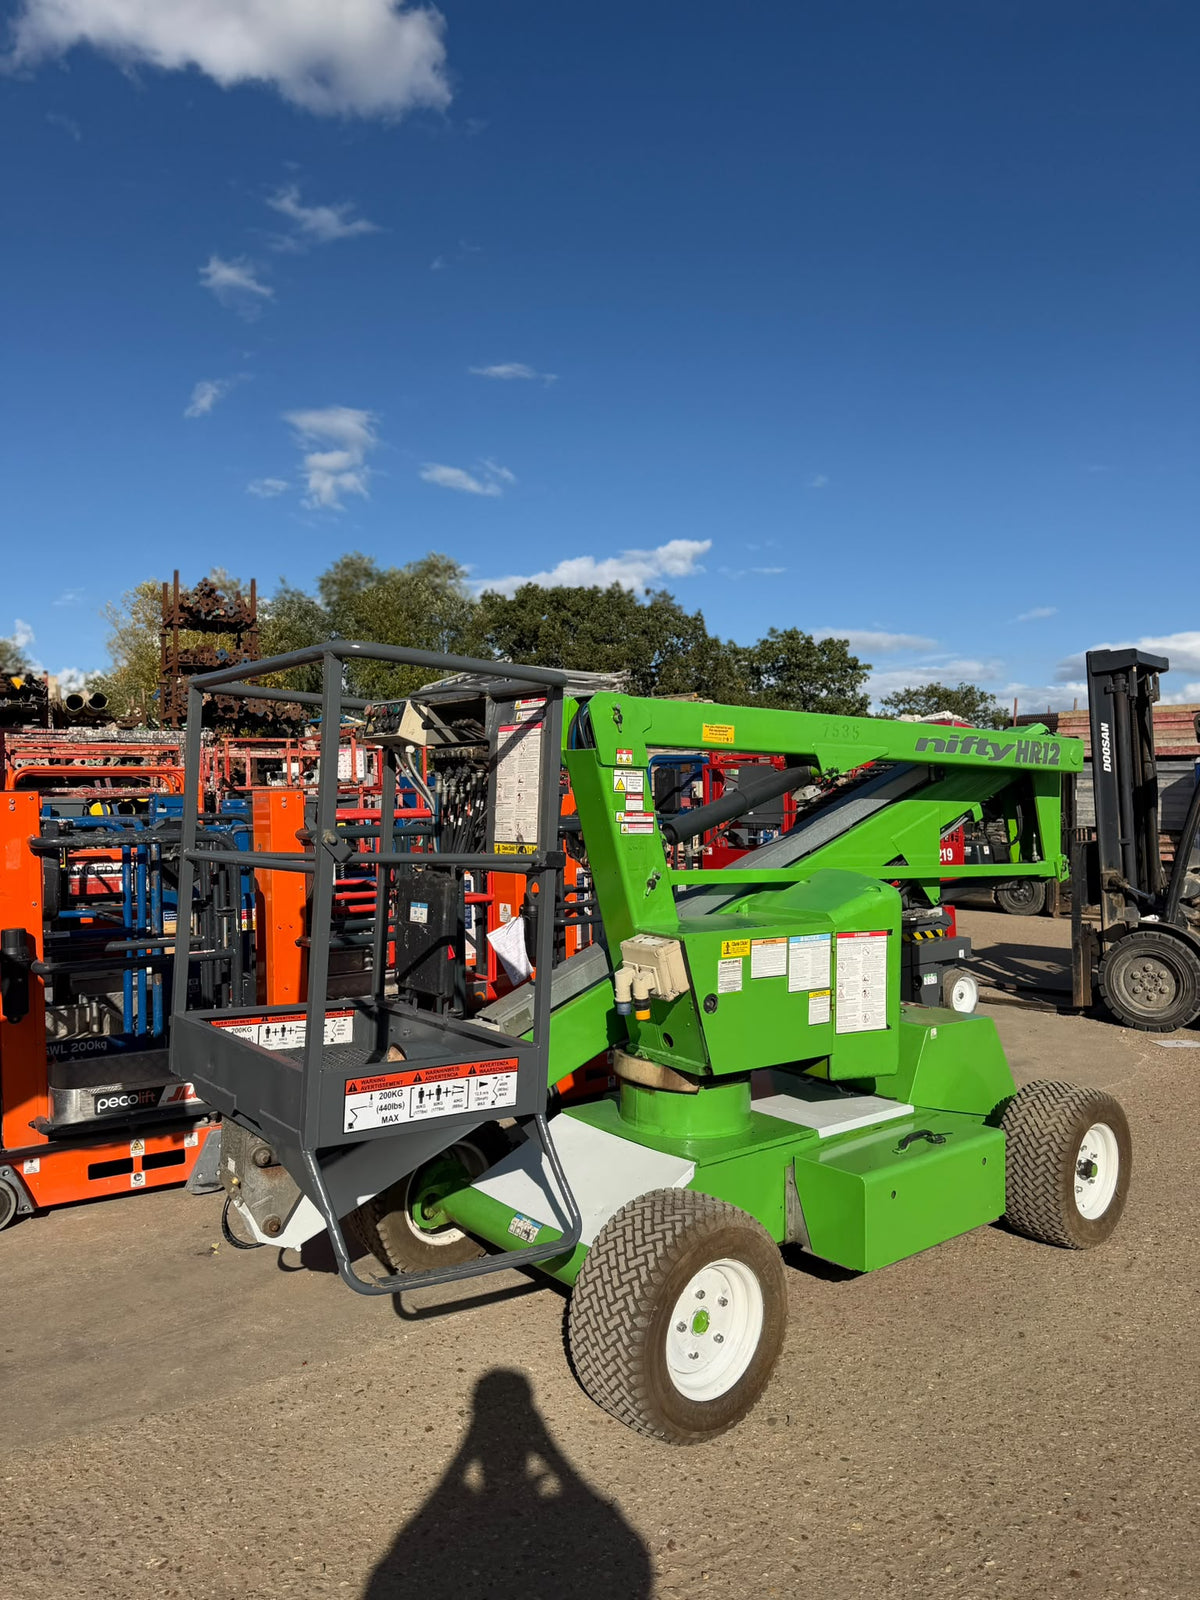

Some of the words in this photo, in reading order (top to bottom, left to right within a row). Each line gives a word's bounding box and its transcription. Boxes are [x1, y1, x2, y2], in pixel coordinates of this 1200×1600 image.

[822, 722, 861, 741] 7535
[915, 735, 1018, 762] nifty
[1014, 739, 1062, 766] HR12
[1100, 722, 1112, 773] DOOSAN
[71, 1039, 108, 1053] 200kg
[360, 1080, 404, 1091] AVERTISSEMENT
[361, 1077, 386, 1085] WARNING
[97, 1090, 156, 1114] pecolift
[378, 1089, 404, 1101] 200KG
[376, 1101, 406, 1115] (440lbs)
[381, 1114, 400, 1125] MAX
